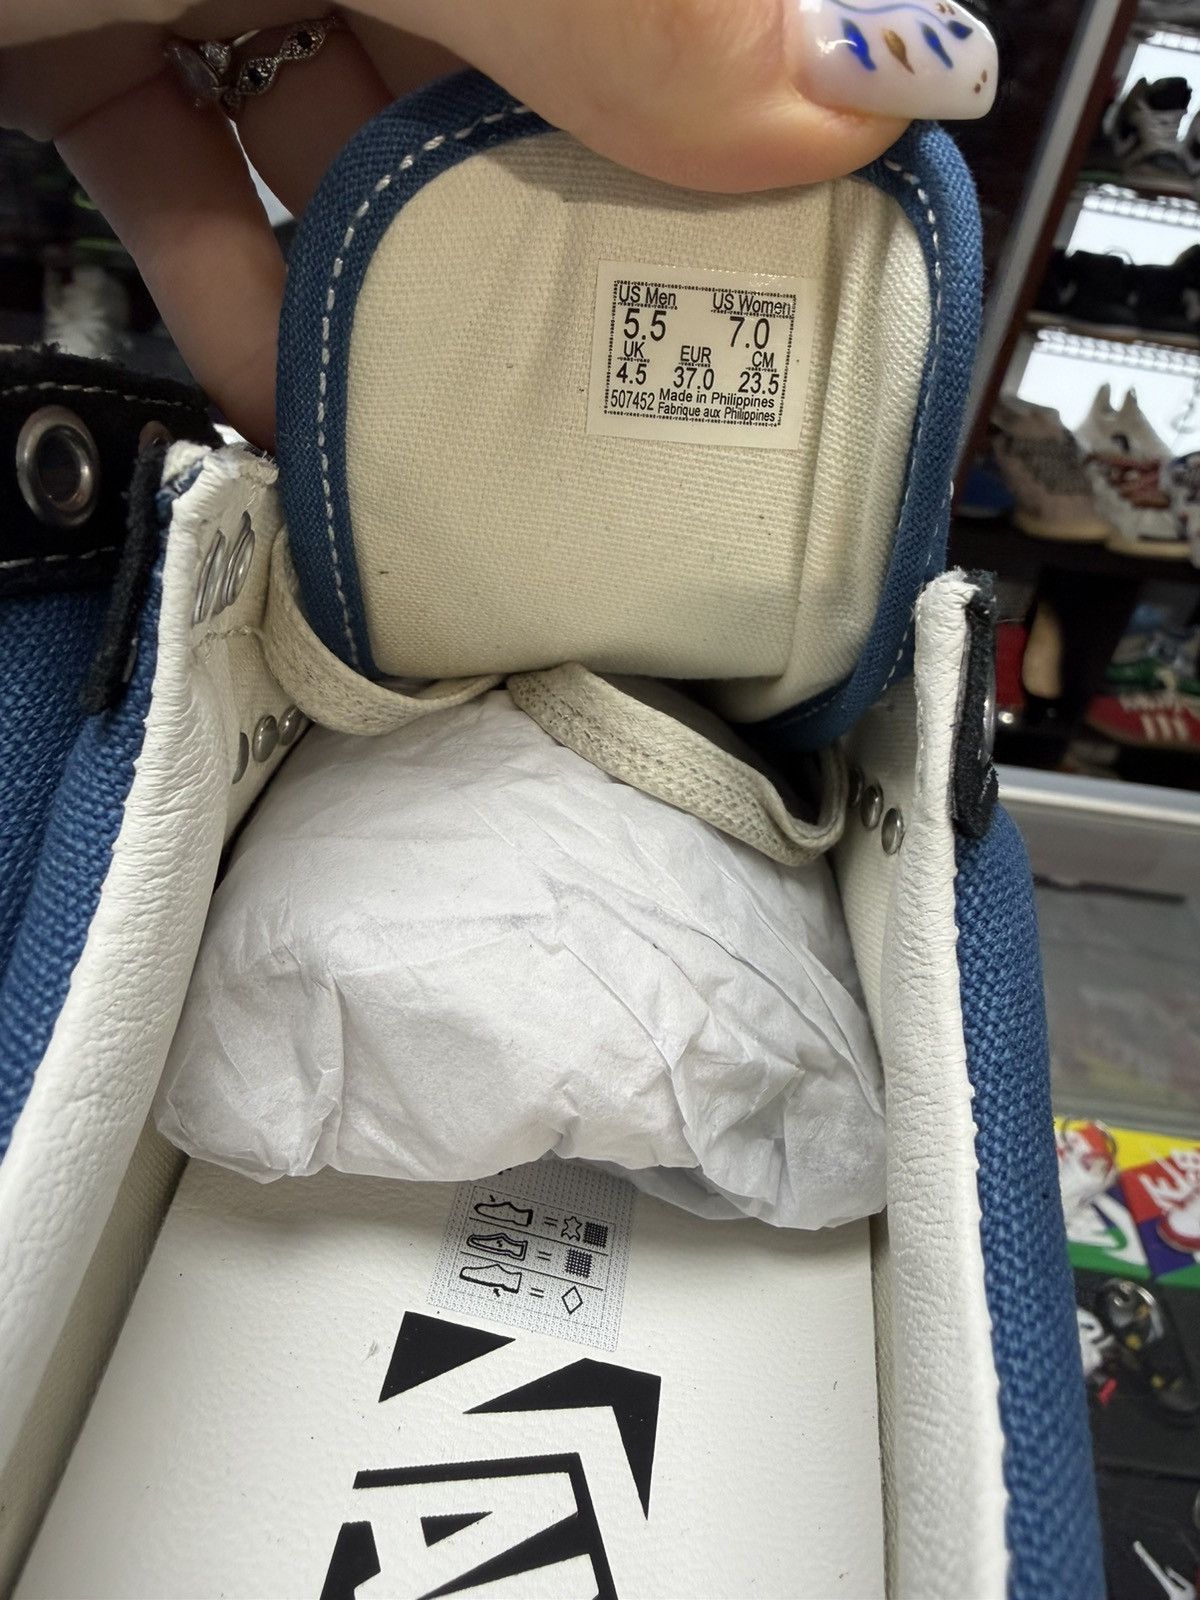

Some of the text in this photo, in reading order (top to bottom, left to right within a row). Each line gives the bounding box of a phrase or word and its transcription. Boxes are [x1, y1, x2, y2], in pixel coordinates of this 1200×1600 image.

[619, 284, 641, 303] US
[645, 287, 677, 306] Men
[713, 292, 735, 311] US
[739, 294, 791, 315] Women
[623, 308, 667, 341] 5.5
[729, 316, 770, 350] 7.0
[623, 340, 645, 359] UK
[680, 345, 711, 364] EUR
[752, 351, 775, 368] CM
[616, 362, 647, 385] 4.5
[673, 366, 715, 390] 37.0
[738, 371, 780, 395] 23.5
[610, 389, 655, 411] 507452
[659, 388, 775, 410] Made in Philippines
[657, 402, 701, 418] Fabrique
[703, 407, 721, 418] aux
[724, 407, 776, 423] Philippines
